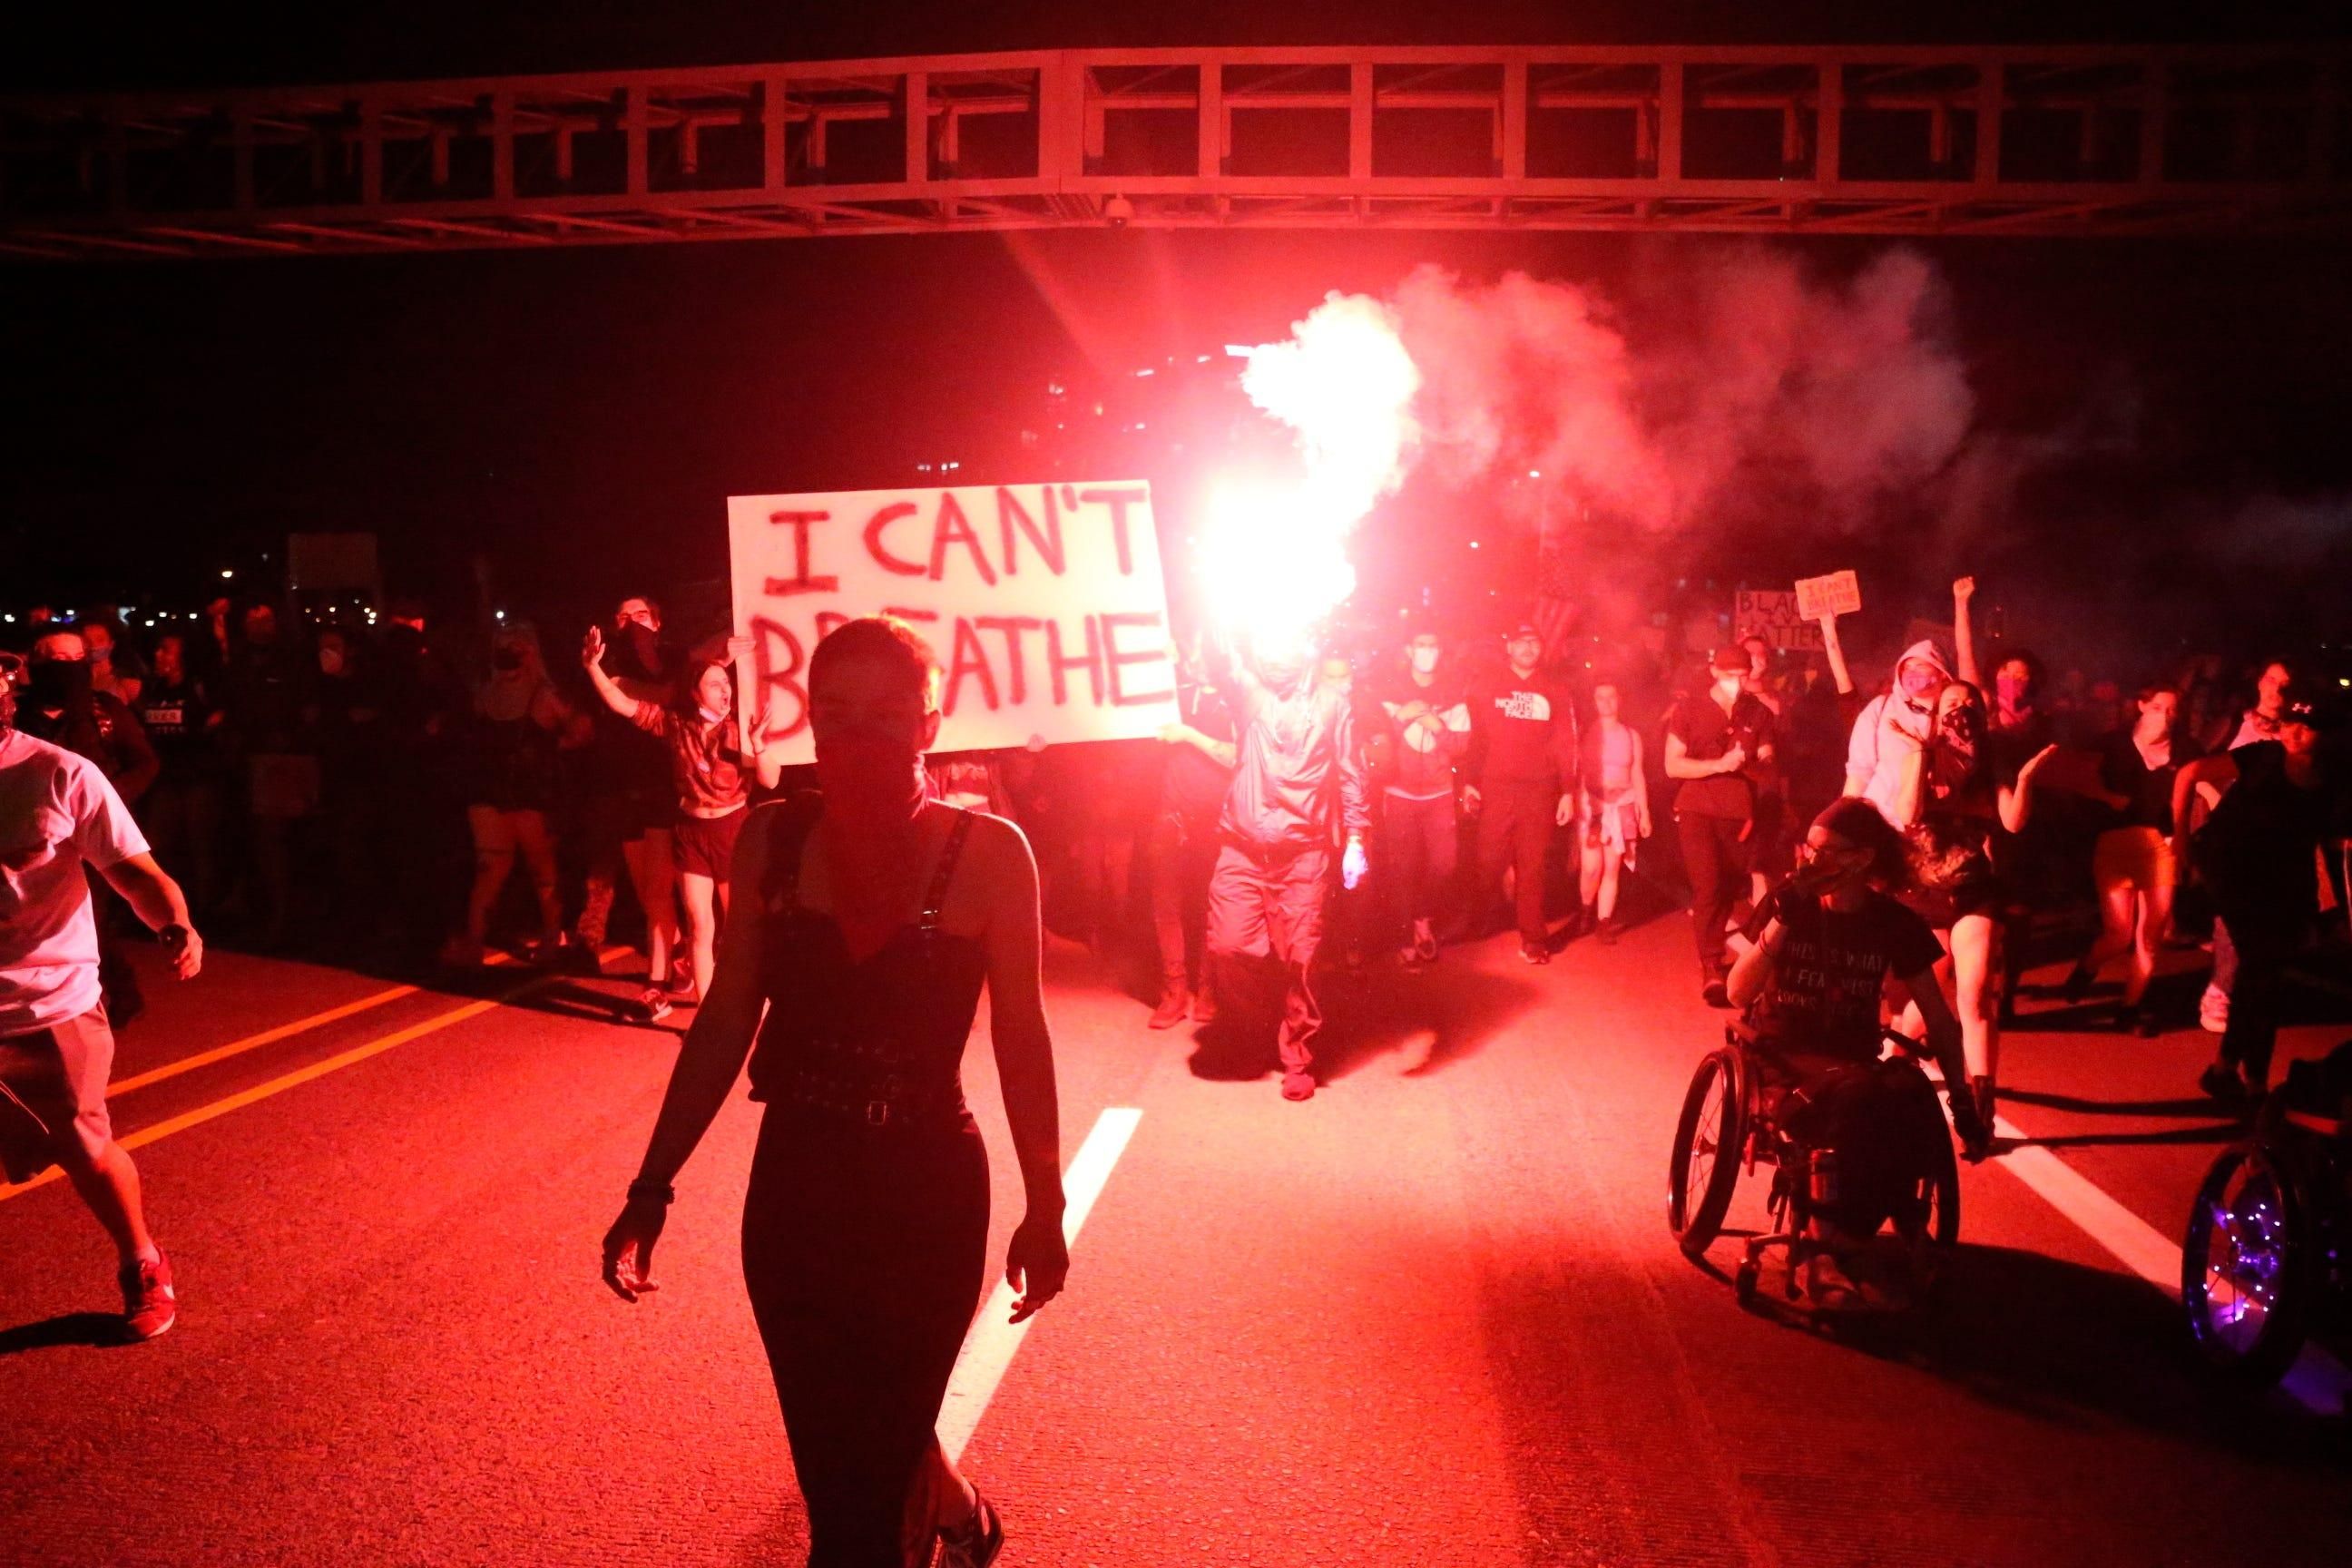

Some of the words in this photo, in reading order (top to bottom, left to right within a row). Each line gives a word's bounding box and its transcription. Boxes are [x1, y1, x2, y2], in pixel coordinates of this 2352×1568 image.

[764, 510, 838, 596] I
[862, 485, 1147, 587] CAN'T
[1510, 691, 1533, 702] THE
[1495, 697, 1533, 712] NORTH
[1504, 708, 1533, 720] FACE
